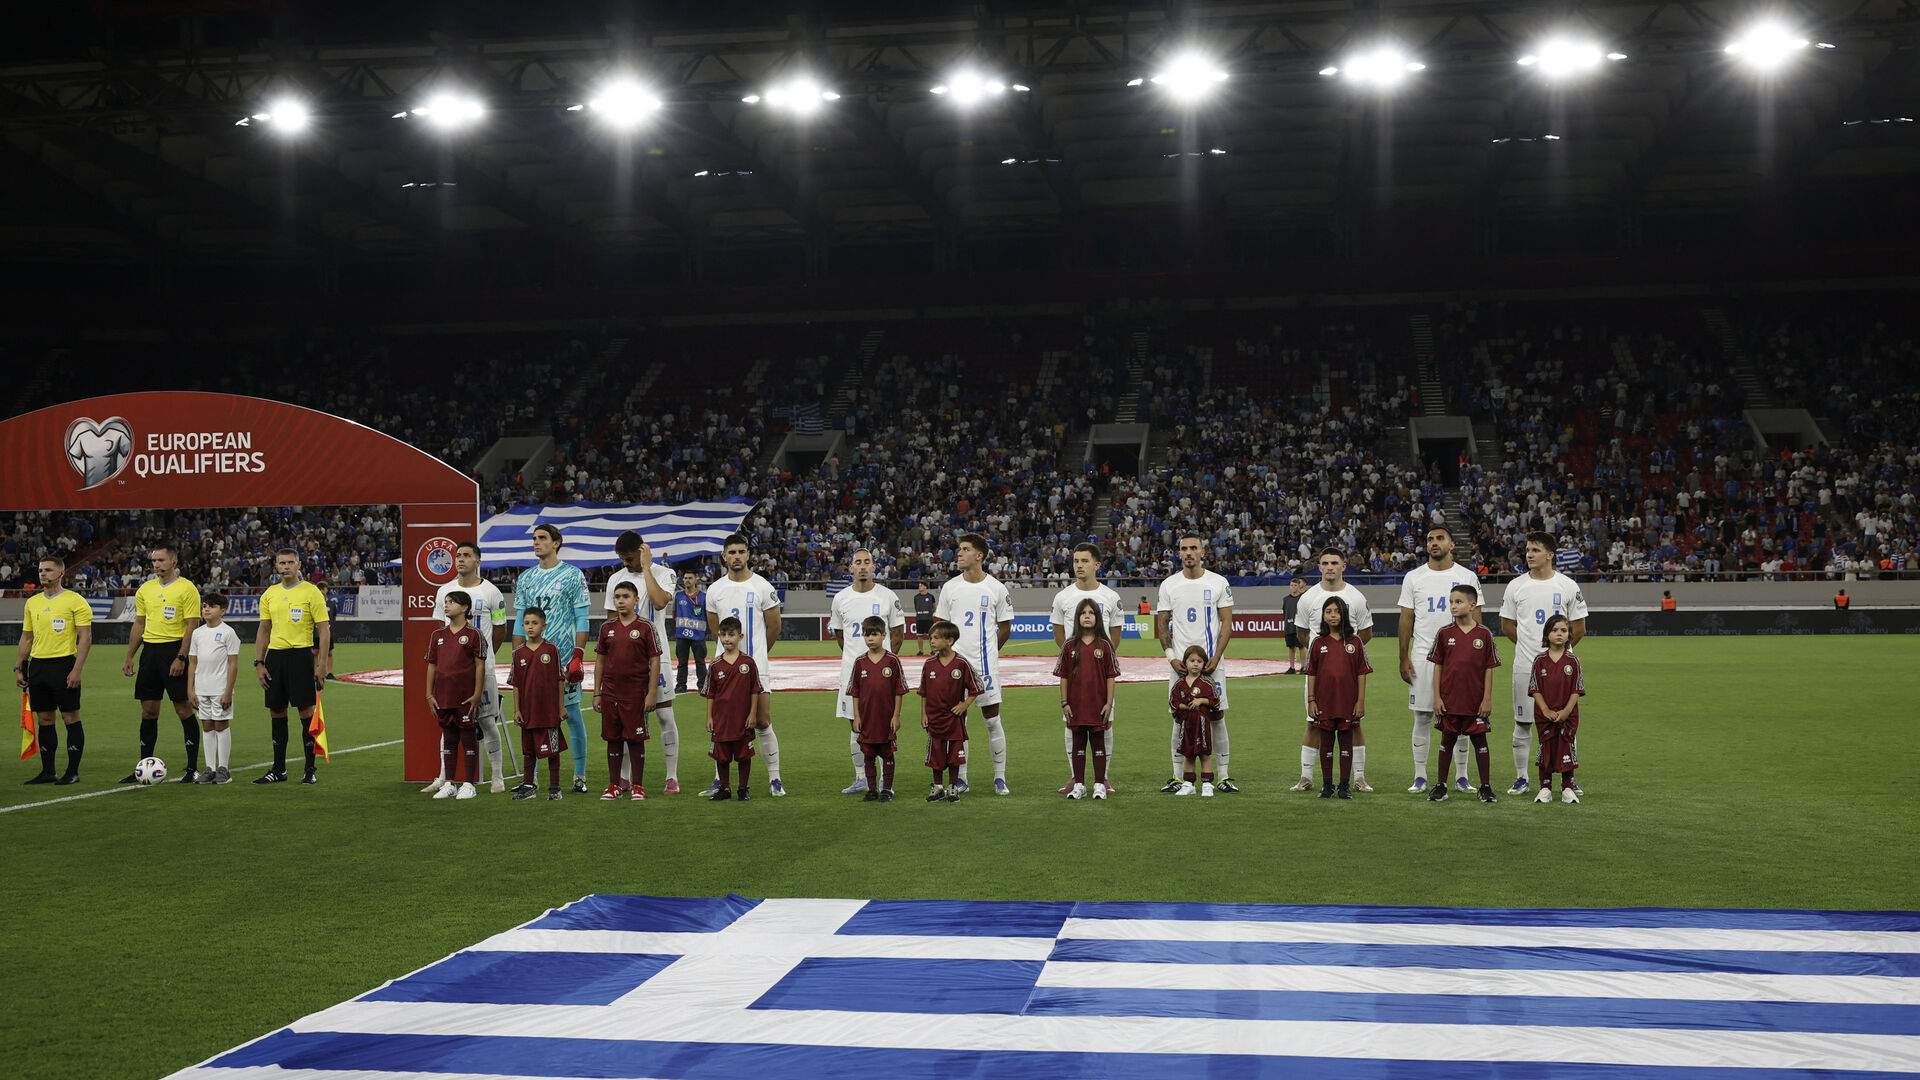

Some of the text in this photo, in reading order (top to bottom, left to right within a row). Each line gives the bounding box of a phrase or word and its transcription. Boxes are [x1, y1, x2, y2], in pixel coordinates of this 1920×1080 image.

[147, 432, 251, 450] EUROPEAN
[134, 452, 266, 478] QUALIFIERS
[425, 540, 453, 551] UEFA
[408, 595, 436, 608] RES
[536, 596, 551, 610] 12
[1427, 596, 1446, 612] 14
[964, 611, 974, 626] 2
[1187, 608, 1197, 622] 6
[1535, 609, 1546, 624] 9
[1010, 624, 1043, 632] WORLD
[983, 675, 994, 691] 2
